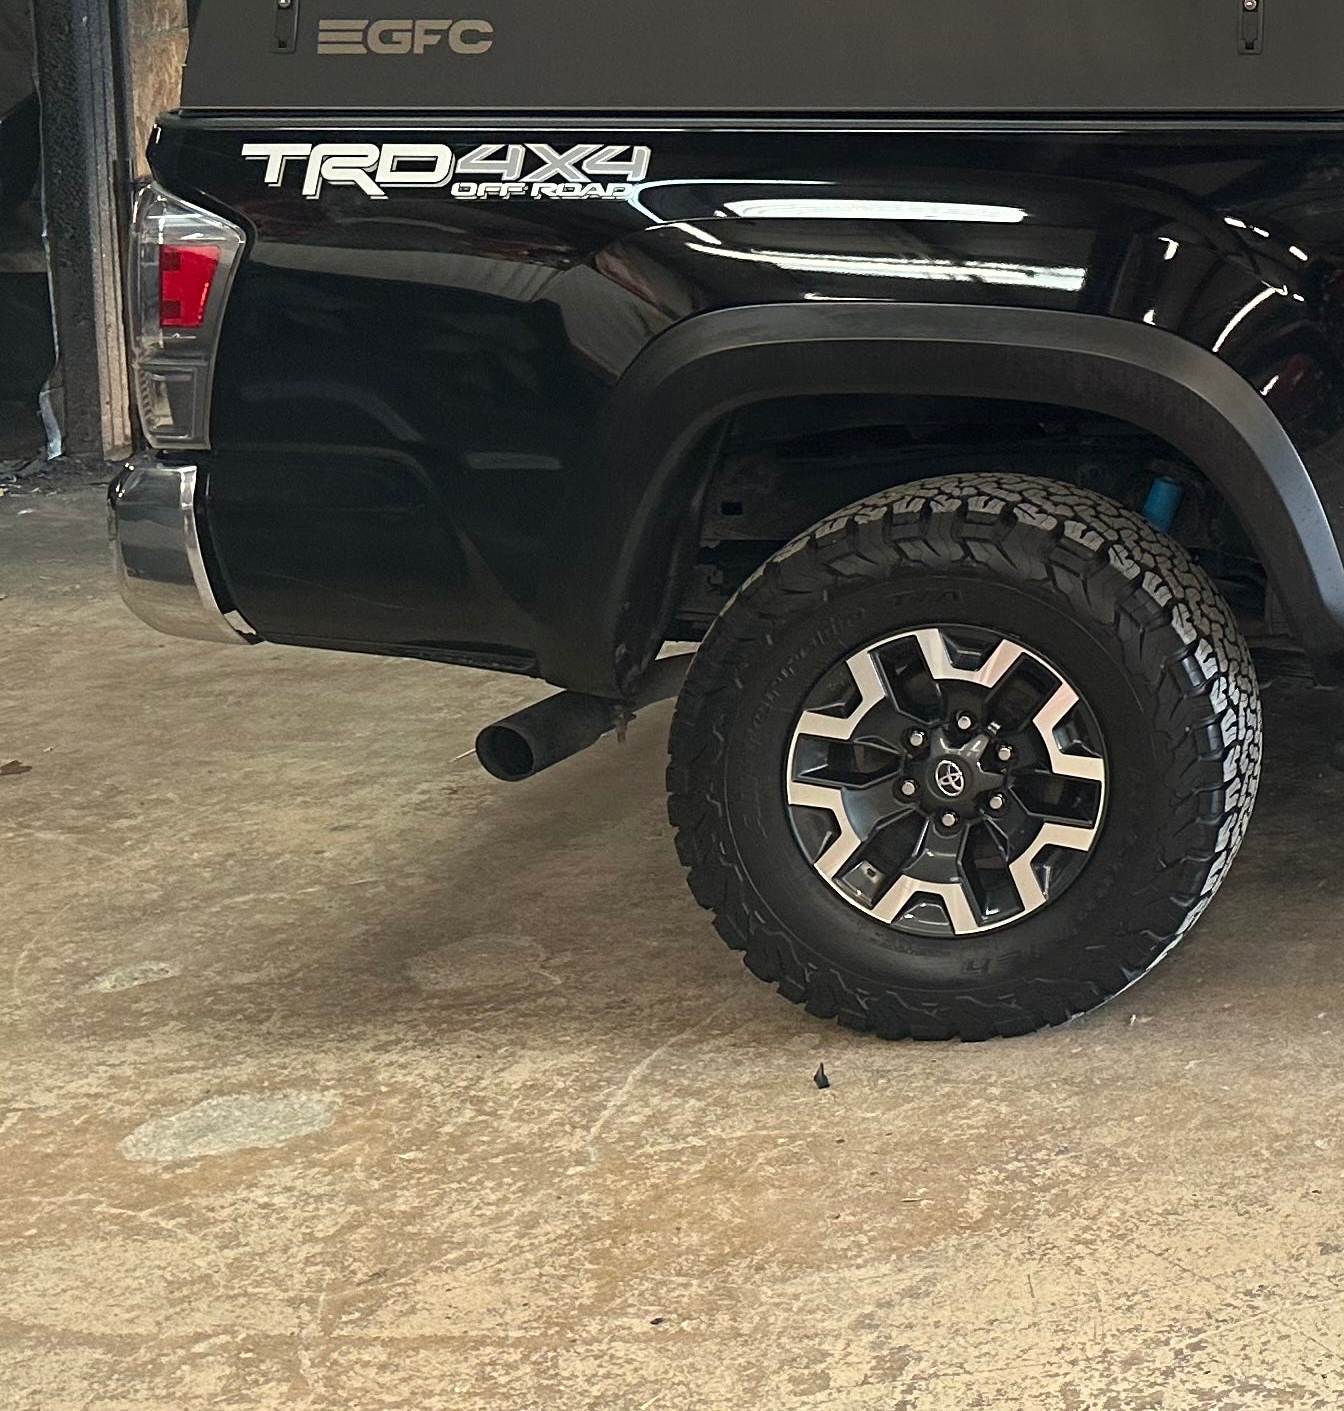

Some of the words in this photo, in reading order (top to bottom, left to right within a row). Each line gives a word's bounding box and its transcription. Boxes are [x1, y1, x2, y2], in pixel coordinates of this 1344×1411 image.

[241, 143, 456, 200] TRD
[450, 182, 525, 201] OFF
[530, 182, 636, 201] ROAD
